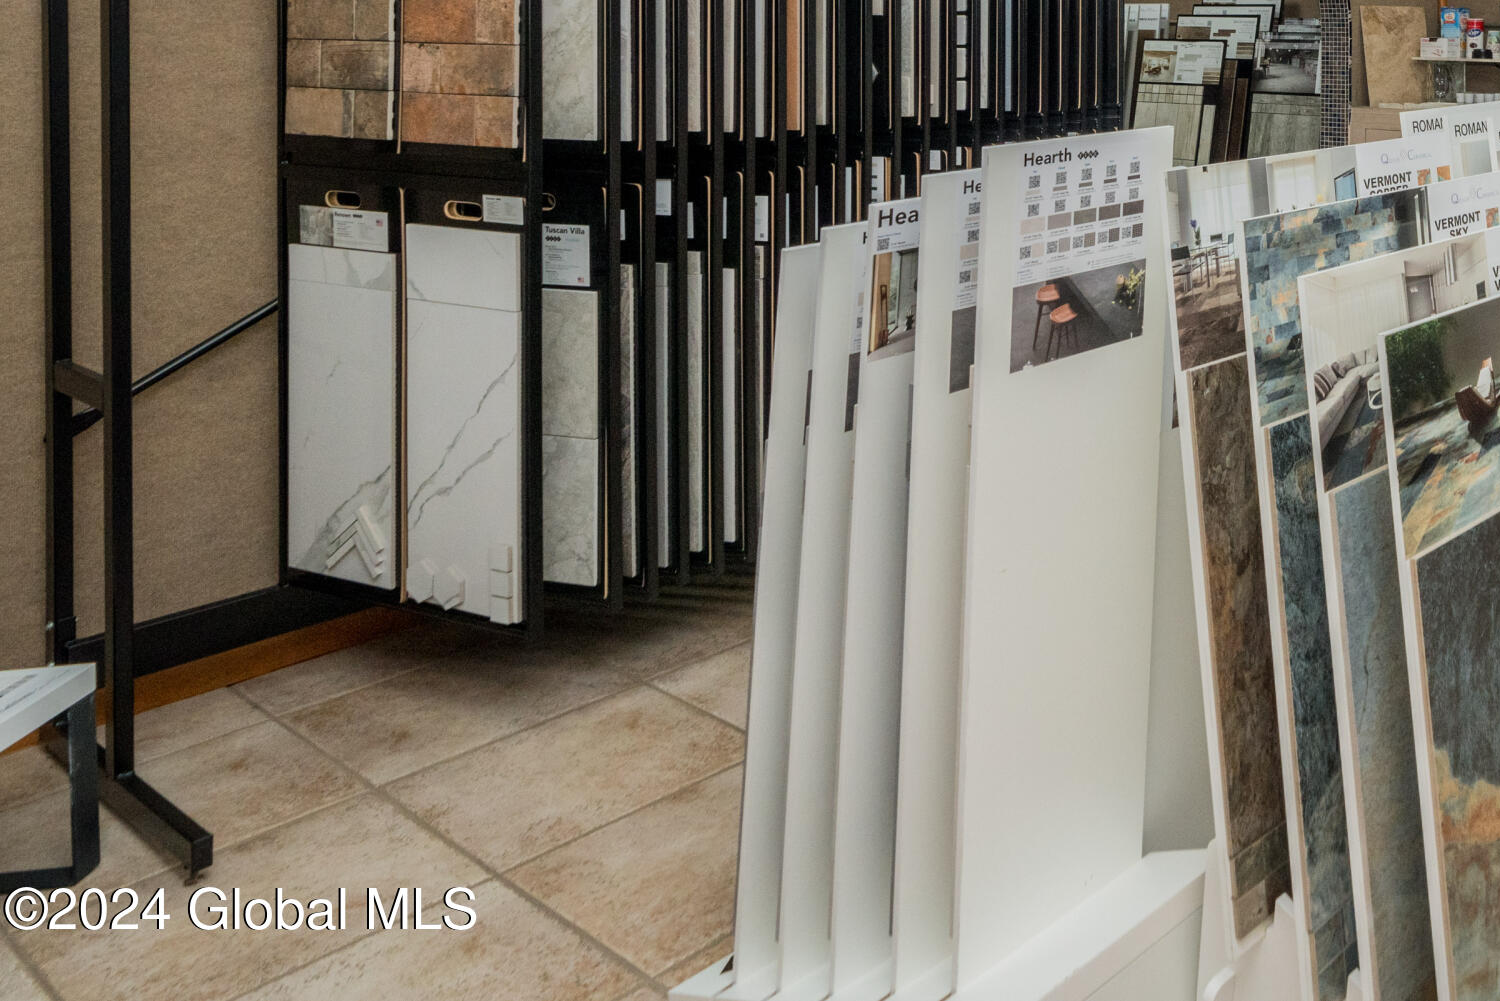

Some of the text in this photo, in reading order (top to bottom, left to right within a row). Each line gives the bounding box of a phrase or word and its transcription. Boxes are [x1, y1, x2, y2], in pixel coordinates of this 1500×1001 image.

[1023, 147, 1072, 168] Hearth
[1363, 171, 1412, 190] VERMONT
[545, 226, 585, 235] Tuscan Villa
[1434, 210, 1481, 231] VERMONT
